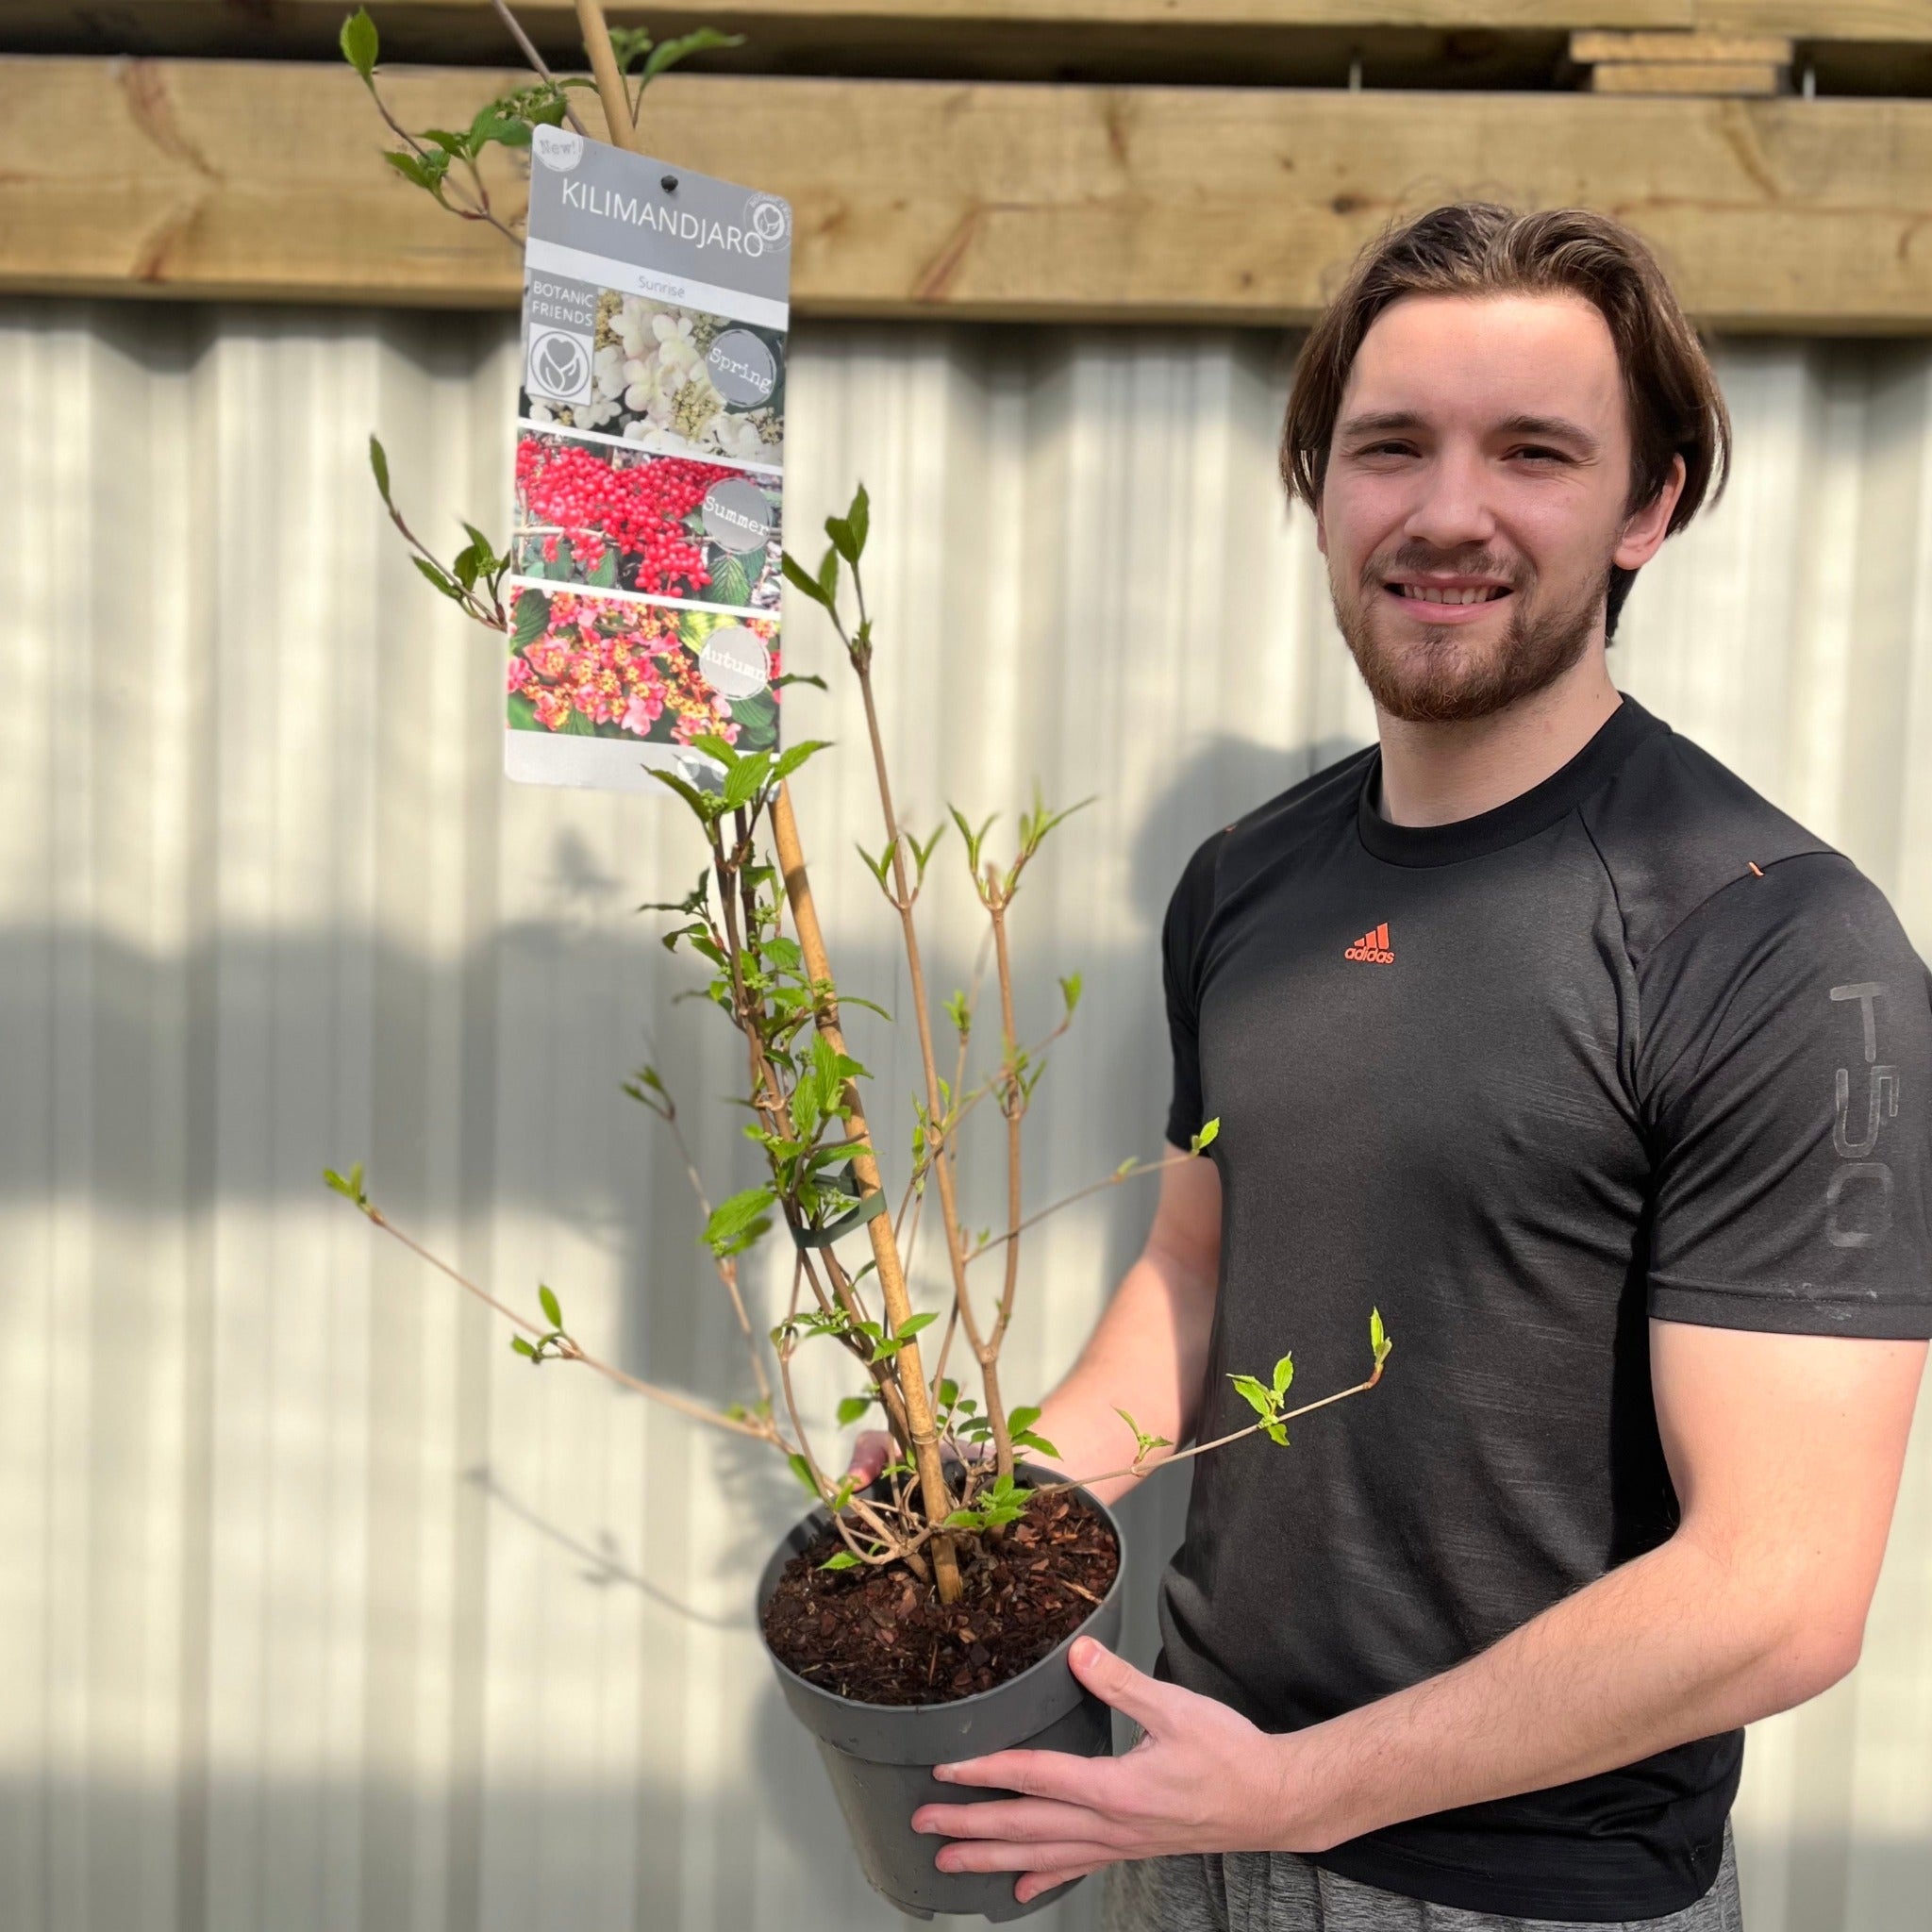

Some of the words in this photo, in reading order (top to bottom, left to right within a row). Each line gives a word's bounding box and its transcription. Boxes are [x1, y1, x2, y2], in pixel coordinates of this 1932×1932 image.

[562, 177, 763, 258] KILIMANDJARO
[533, 280, 594, 308] BOTANIC
[638, 275, 686, 298] Sunrise
[532, 300, 593, 327] FRIENDS
[709, 347, 773, 394] Spring
[703, 495, 770, 536] Summer
[700, 642, 766, 684] Autumn
[1344, 946, 1395, 964] adidas
